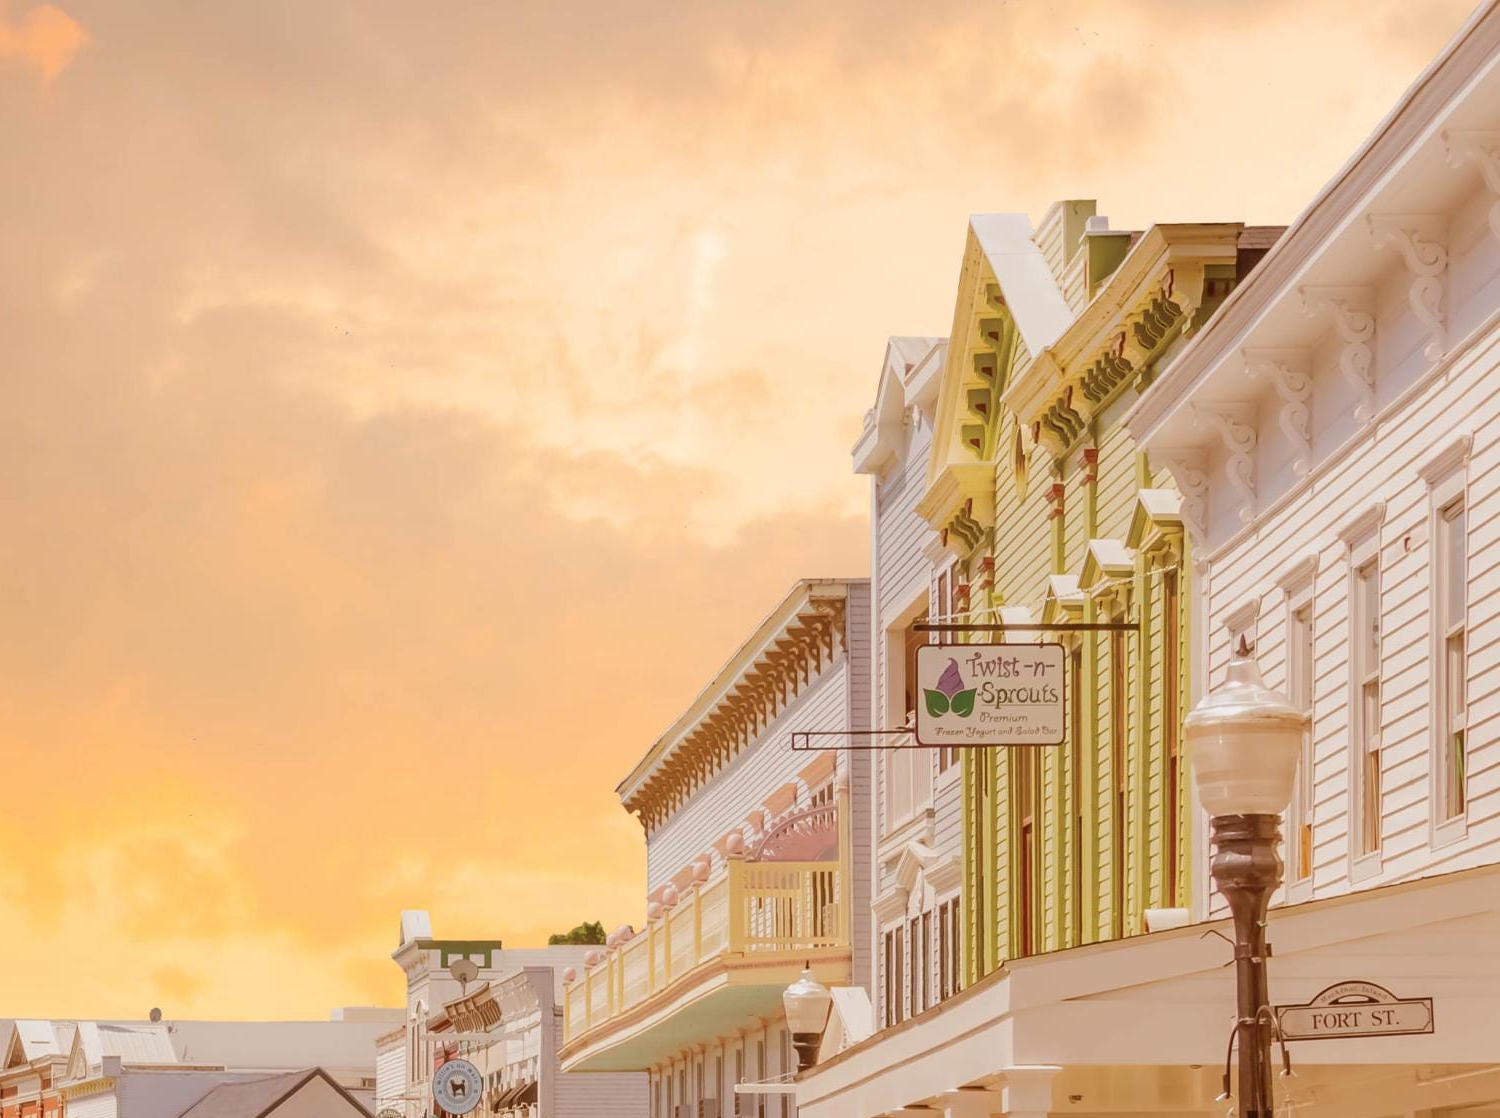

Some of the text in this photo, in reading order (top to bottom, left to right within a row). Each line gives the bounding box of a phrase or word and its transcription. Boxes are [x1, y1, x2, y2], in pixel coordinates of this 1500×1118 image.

[966, 651, 1020, 678] Twist
[977, 681, 1059, 709] Sprouts
[980, 712, 1028, 722] Premium
[935, 727, 964, 736] Frozen
[999, 727, 1013, 735] and
[1015, 726, 1040, 735] Salad
[1042, 726, 1058, 735] Bar
[1312, 1010, 1400, 1030] FORT ST.
